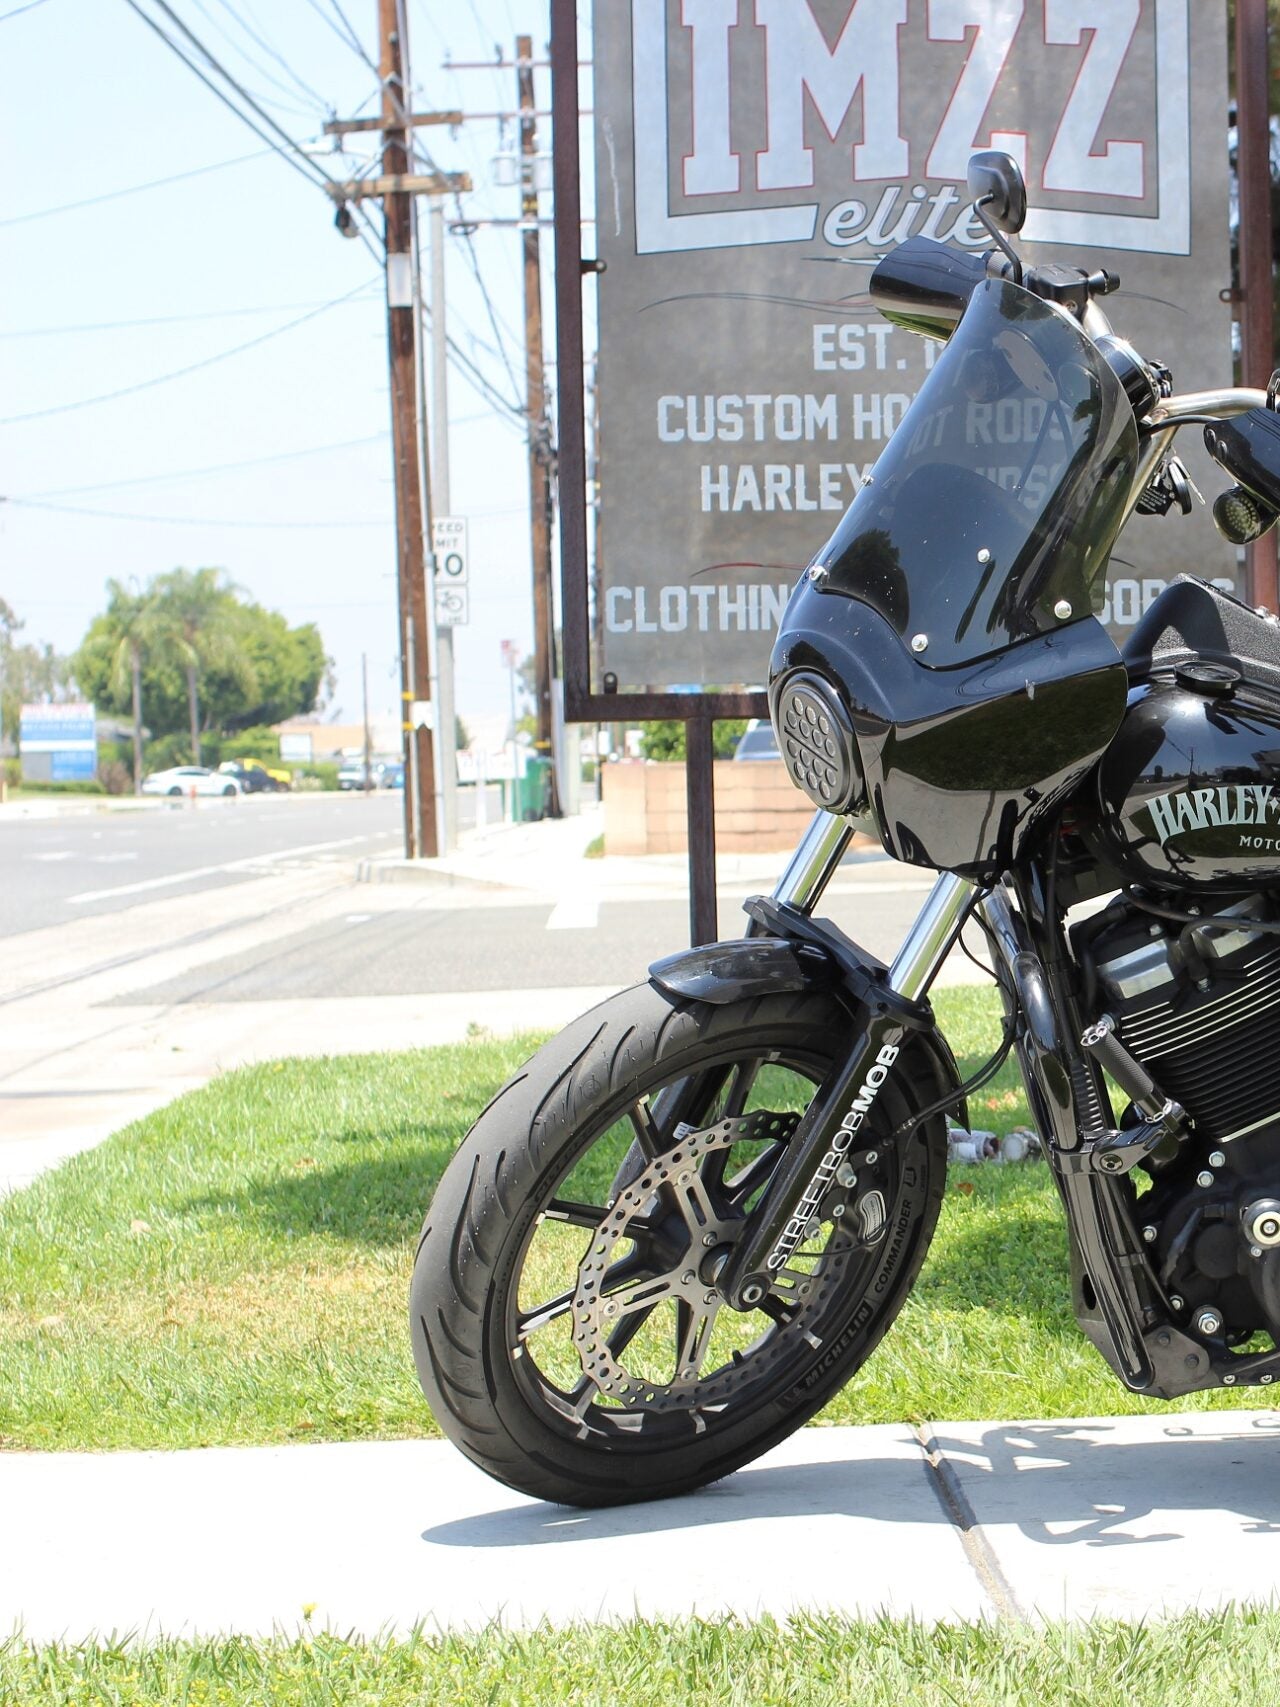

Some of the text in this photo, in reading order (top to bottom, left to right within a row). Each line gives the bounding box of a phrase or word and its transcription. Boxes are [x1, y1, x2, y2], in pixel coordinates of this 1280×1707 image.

[680, 0, 1144, 199] IMZZ
[823, 184, 1008, 247] elite
[813, 324, 906, 371] EST.
[656, 394, 838, 442] CUSTOM
[432, 523, 464, 533] EED
[435, 539, 459, 548] MIT
[604, 584, 800, 633] CLOTHIN
[873, 1200, 913, 1294] COMMANDER
[804, 1306, 870, 1387] MICHELIN
